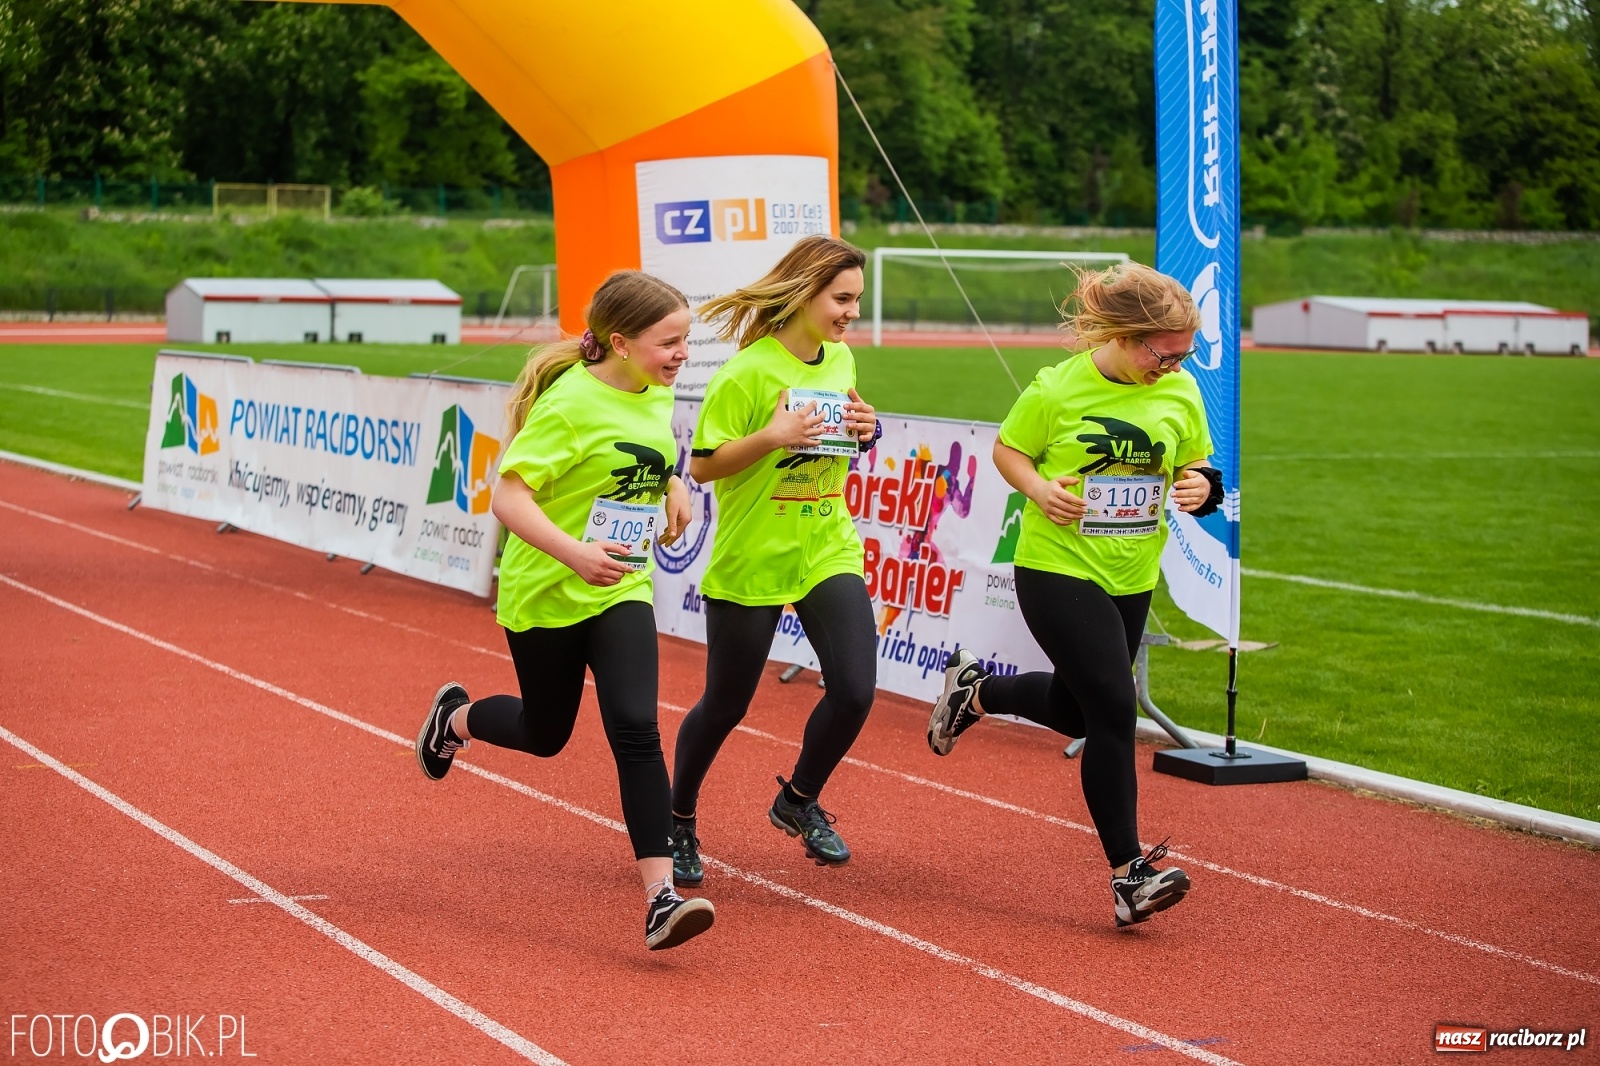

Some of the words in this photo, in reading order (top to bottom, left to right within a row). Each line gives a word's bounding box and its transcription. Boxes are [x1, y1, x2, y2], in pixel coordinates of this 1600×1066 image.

[230, 399, 301, 446] POWIAT
[304, 408, 420, 467] RACIBORSKI
[1110, 440, 1133, 457] VI
[844, 457, 937, 529] orski
[1106, 487, 1147, 507] 110
[1153, 486, 1160, 496] R
[607, 519, 643, 542] 109
[647, 516, 654, 527] R
[863, 537, 965, 616] Barier
[683, 584, 700, 613] dla
[889, 631, 916, 664] ich
